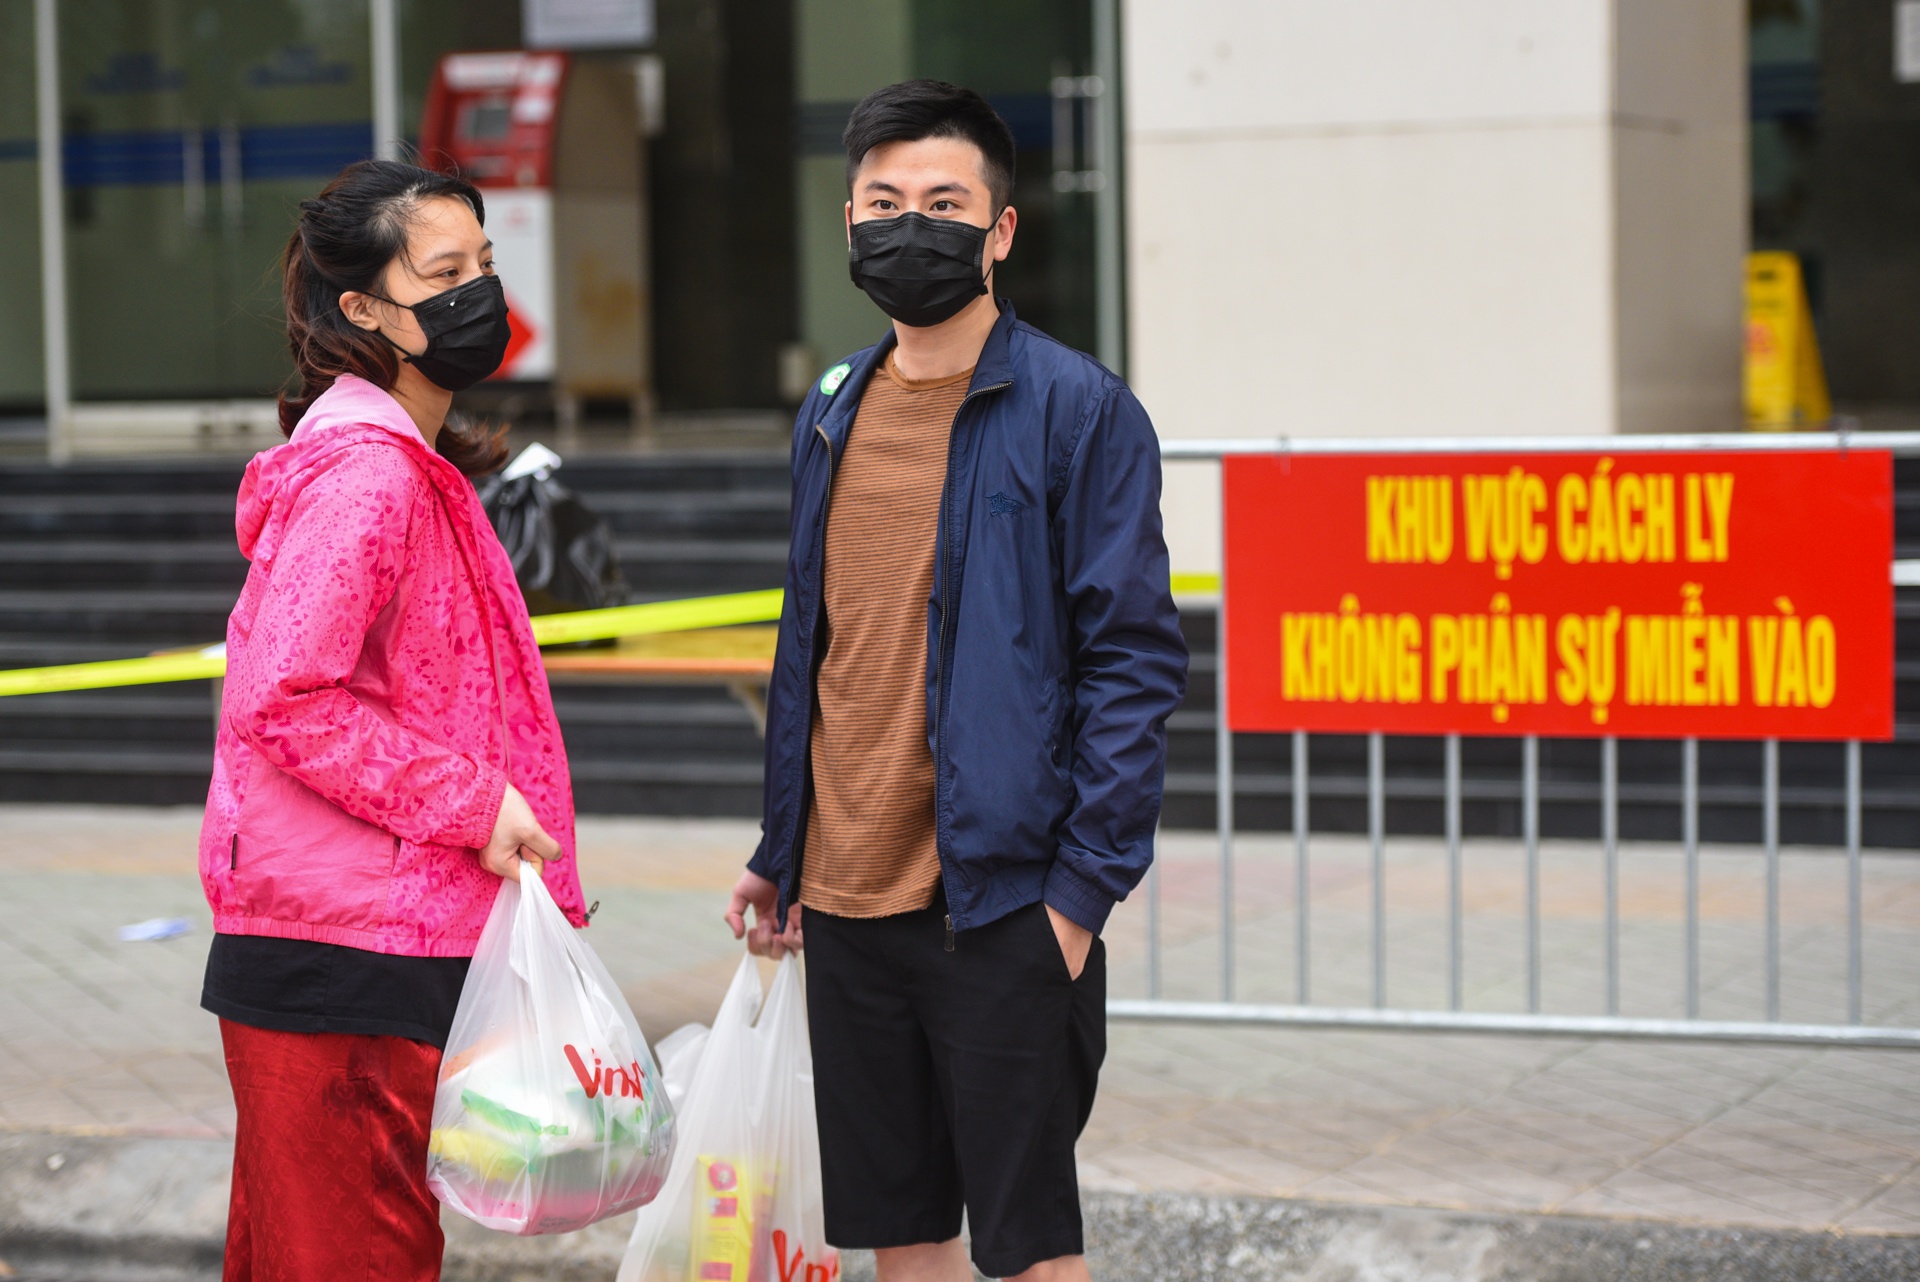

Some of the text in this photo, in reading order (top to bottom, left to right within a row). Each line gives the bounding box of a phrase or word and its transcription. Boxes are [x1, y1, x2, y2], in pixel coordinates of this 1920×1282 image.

[1366, 457, 1734, 580] KHU VỰC CÁCH LY
[1281, 582, 1836, 725] KHÔNG PHẬN SỰ MIỄN VÀO
